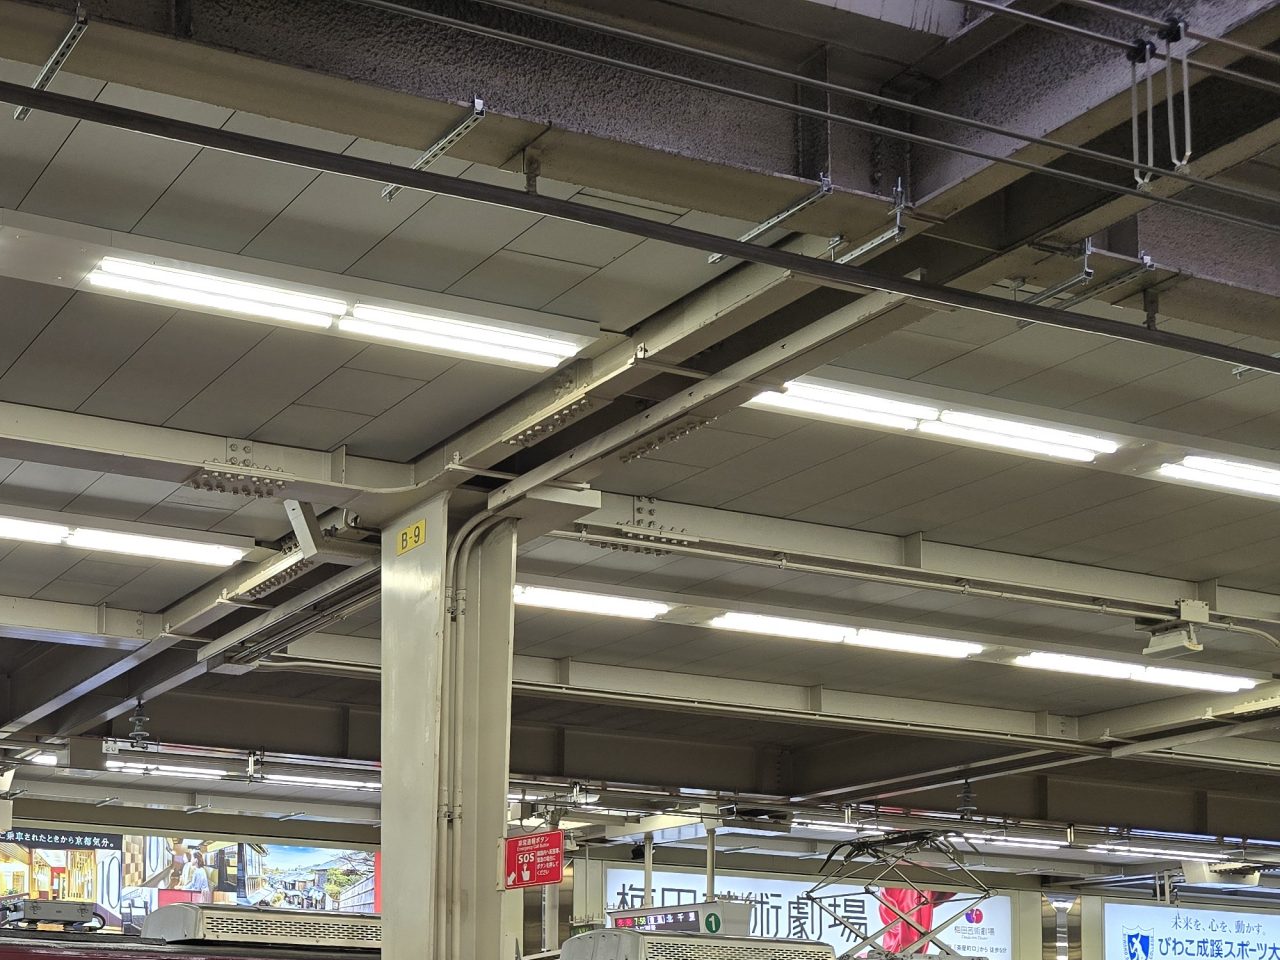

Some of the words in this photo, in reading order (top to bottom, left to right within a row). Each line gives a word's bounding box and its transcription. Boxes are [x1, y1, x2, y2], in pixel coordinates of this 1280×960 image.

[401, 526, 421, 550] B-9
[518, 853, 535, 864] SOS
[708, 915, 716, 931] 1
[1171, 913, 1266, 936] 未来を、心を、動かす。
[1158, 937, 1280, 960] びわこ成蹊スポーツ大
